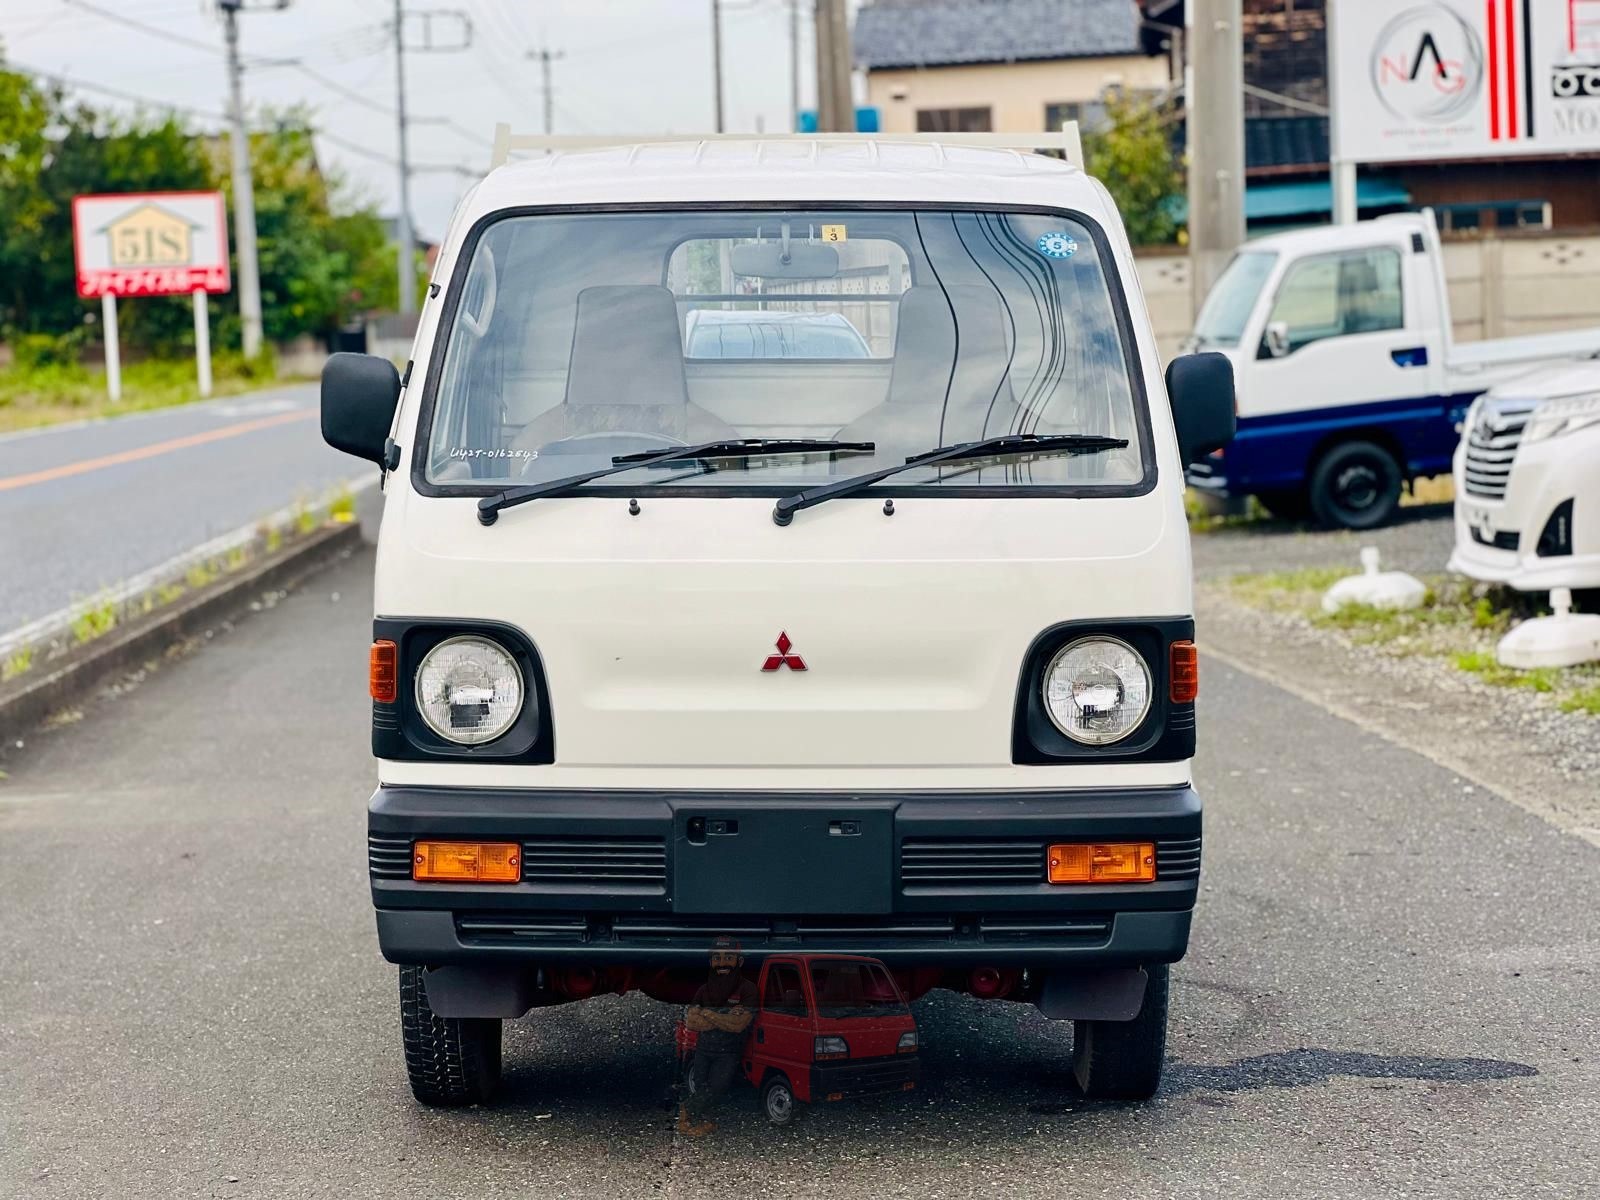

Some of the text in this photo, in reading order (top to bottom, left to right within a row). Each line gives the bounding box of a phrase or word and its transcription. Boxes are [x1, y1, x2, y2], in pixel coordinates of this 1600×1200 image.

[1553, 107, 1600, 137] MO
[830, 233, 838, 241] 3
[1053, 241, 1062, 250] 5
